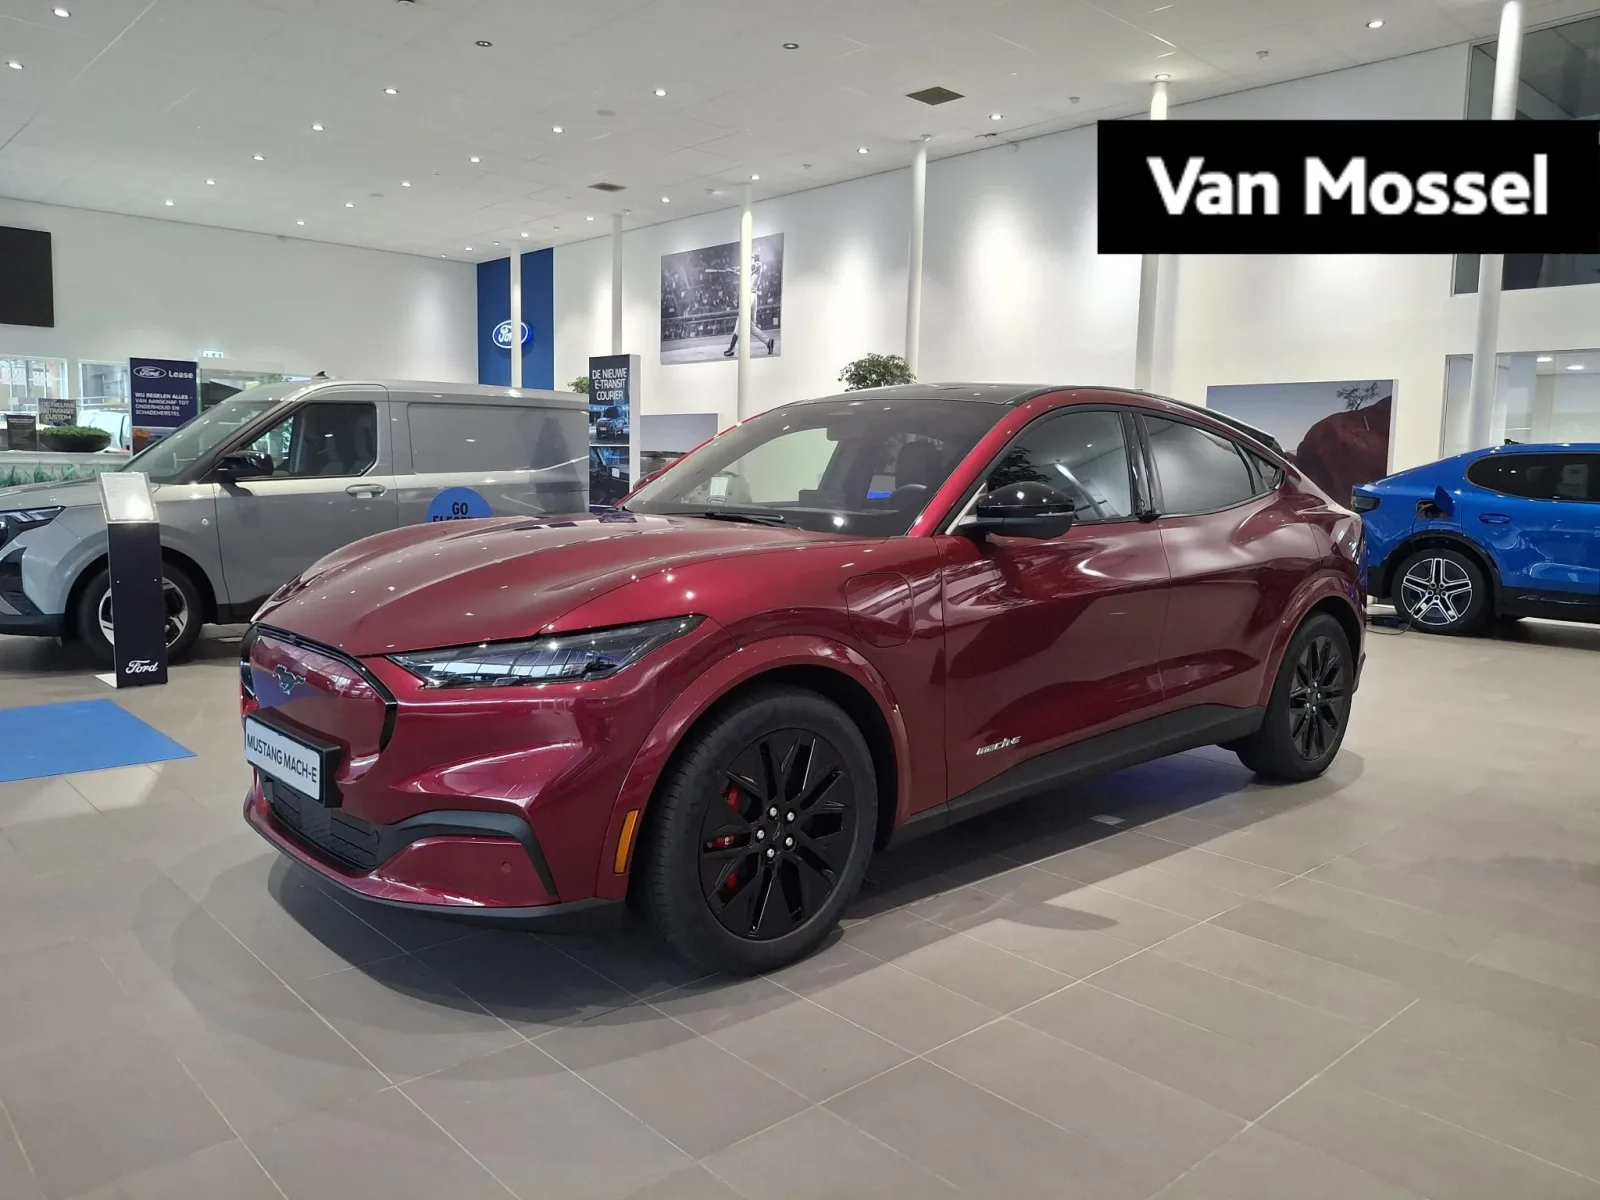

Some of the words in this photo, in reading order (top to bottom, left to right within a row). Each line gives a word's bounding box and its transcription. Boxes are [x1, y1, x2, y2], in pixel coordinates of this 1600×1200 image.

[168, 370, 194, 379] Lease
[592, 369, 601, 380] DE
[602, 368, 628, 379] NIEUWE
[594, 378, 626, 390] E-TRANSIT
[596, 390, 624, 401] COURIER
[452, 501, 469, 515] GO
[125, 659, 160, 674] Ford
[247, 733, 283, 765] MUSTANG
[284, 752, 317, 784] MACH-E
